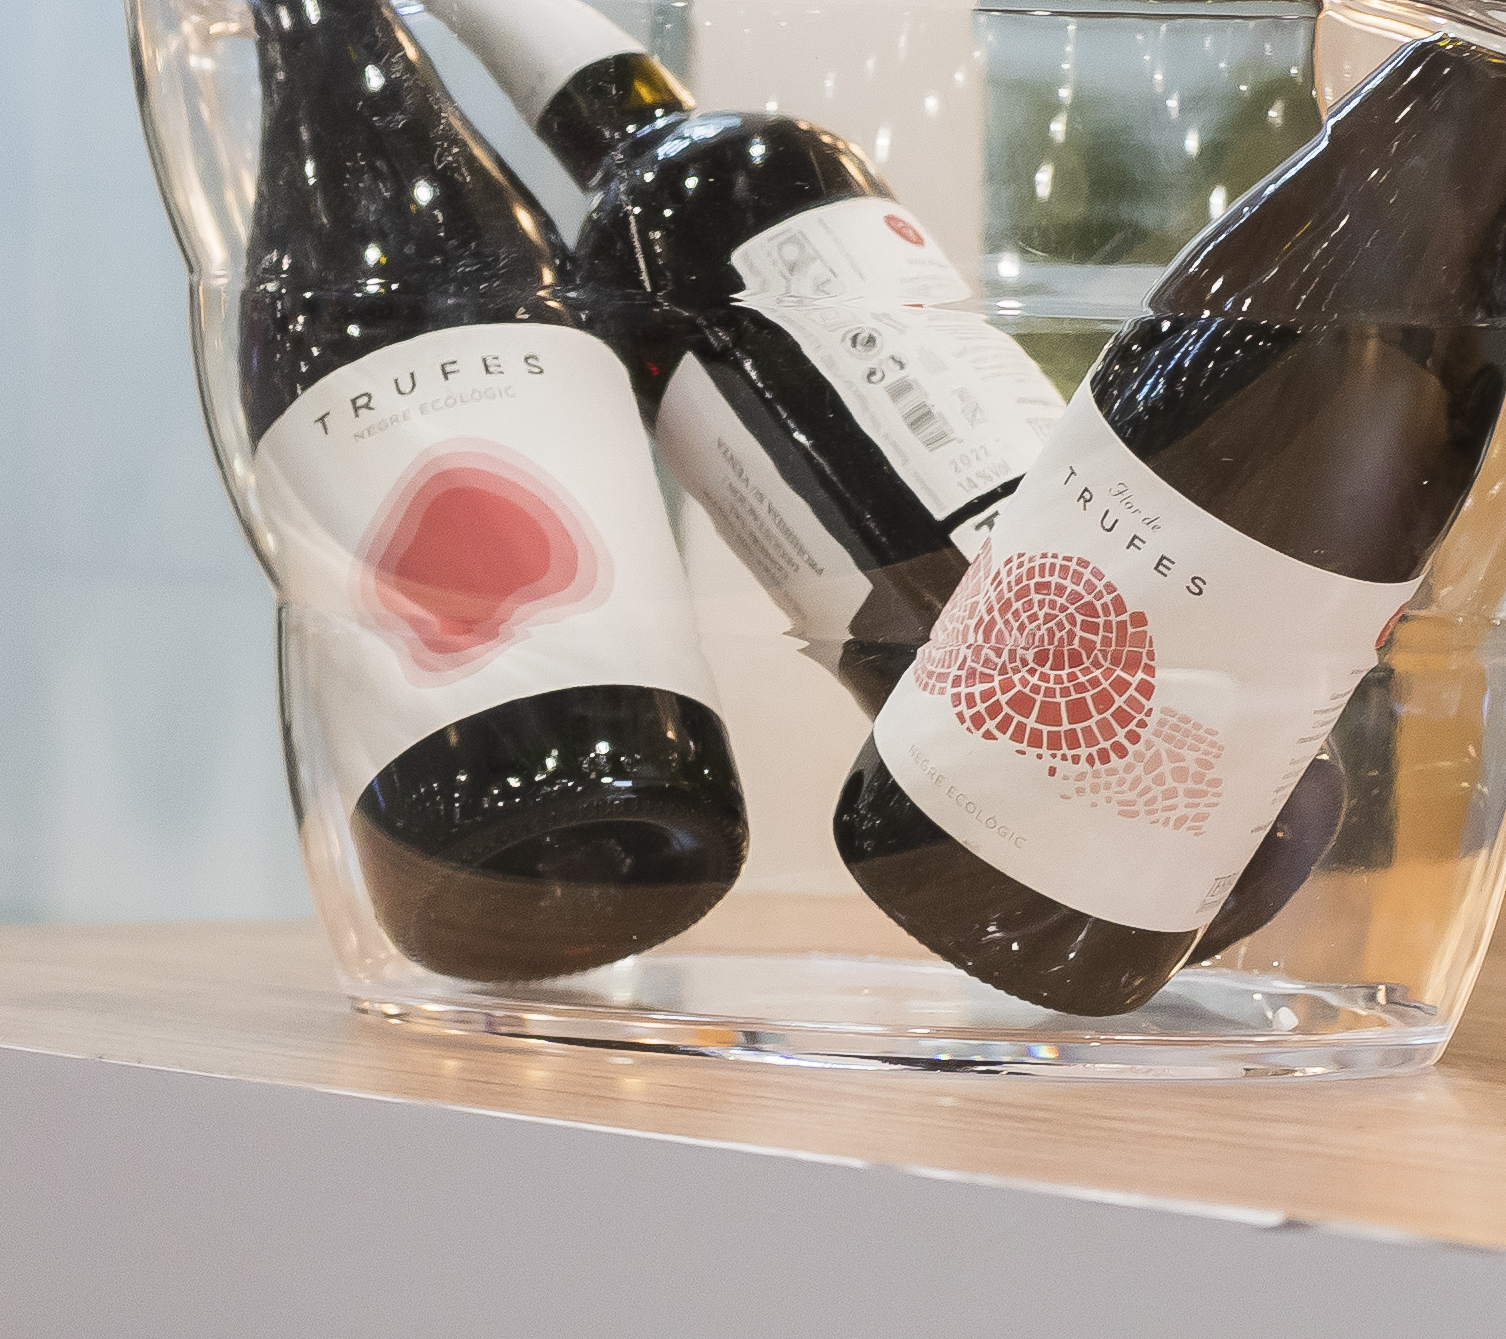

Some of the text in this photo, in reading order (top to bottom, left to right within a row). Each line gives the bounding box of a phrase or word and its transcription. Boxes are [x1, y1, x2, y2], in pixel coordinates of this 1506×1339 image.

[313, 352, 545, 436] TRUFES
[352, 406, 412, 442] NEGRE
[1063, 465, 1208, 597] TRUFES
[1108, 481, 1162, 533] Flor de
[909, 744, 947, 787] NEGRE
